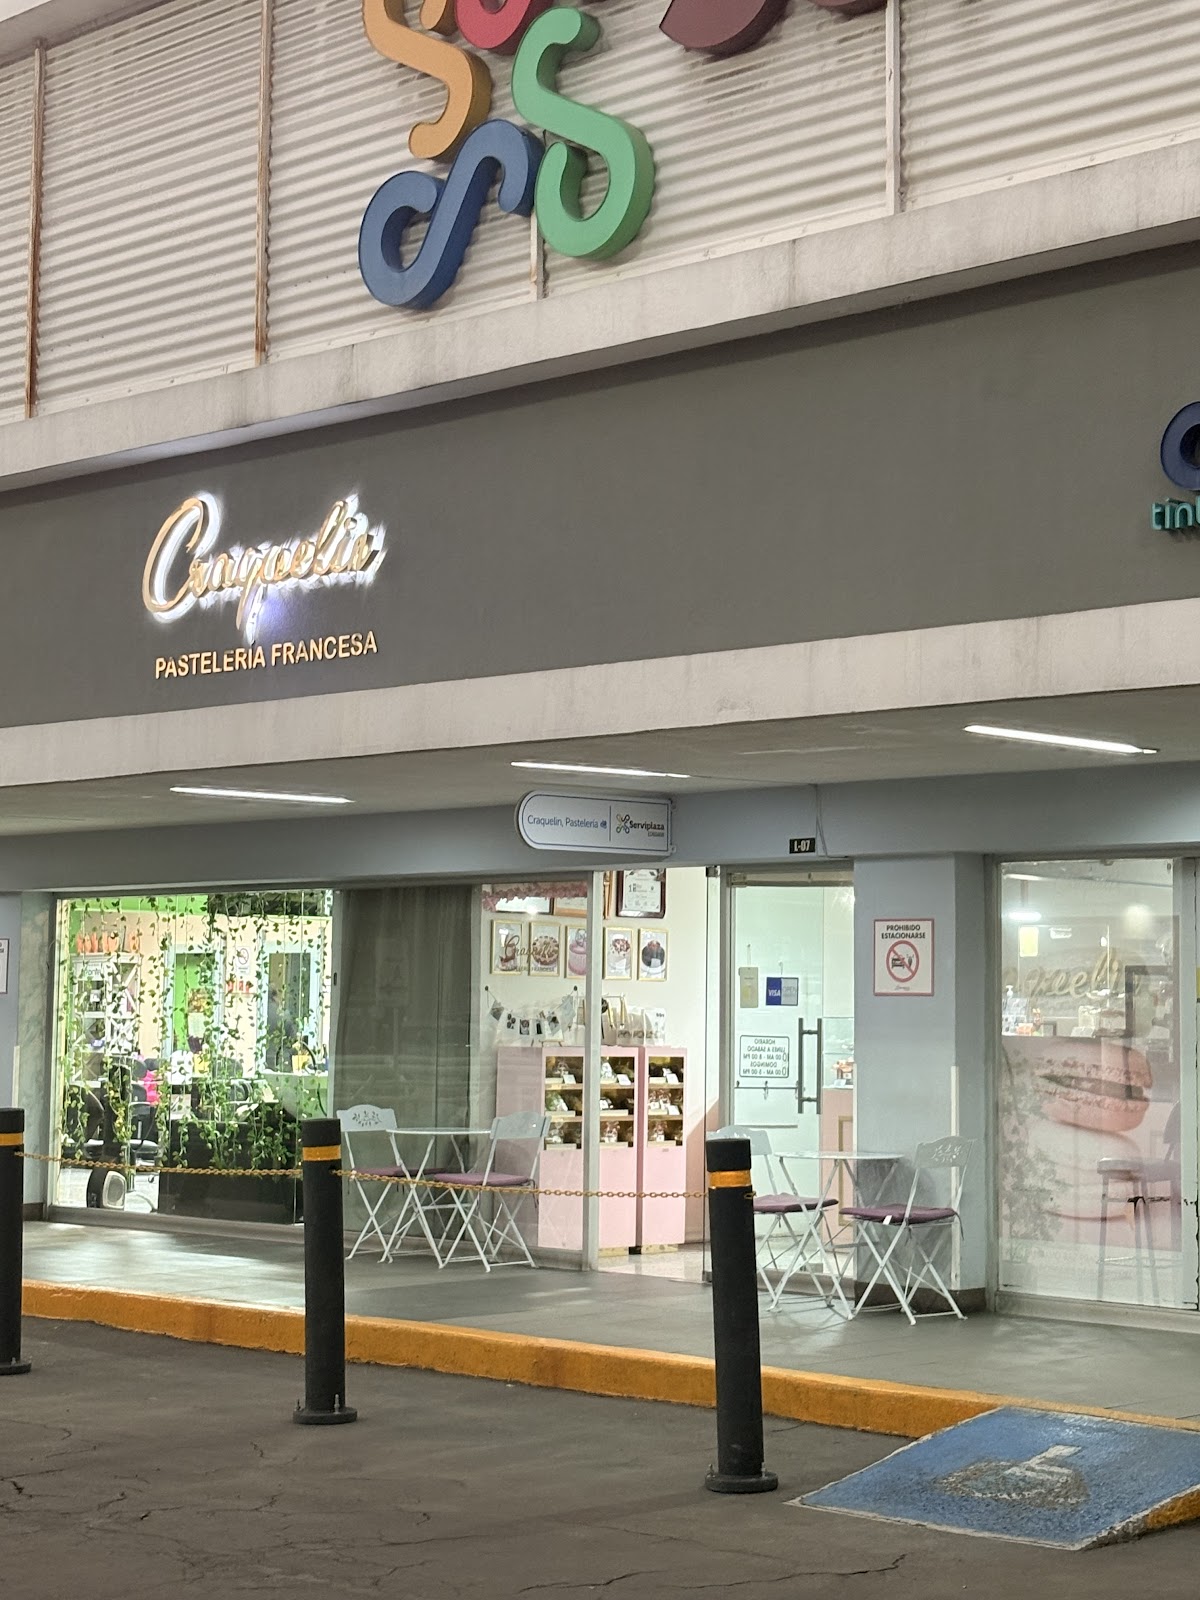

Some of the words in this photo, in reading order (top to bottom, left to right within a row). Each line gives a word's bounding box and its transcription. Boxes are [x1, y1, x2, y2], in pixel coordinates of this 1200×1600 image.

[271, 631, 379, 668] FRANCESA
[527, 814, 564, 828] Craquelin,
[629, 820, 665, 831] Serviplaza
[793, 839, 811, 852] L-07
[886, 924, 921, 932] PROHIBIDO
[881, 932, 926, 940] ESTACIONARSE
[768, 989, 781, 997] VISA
